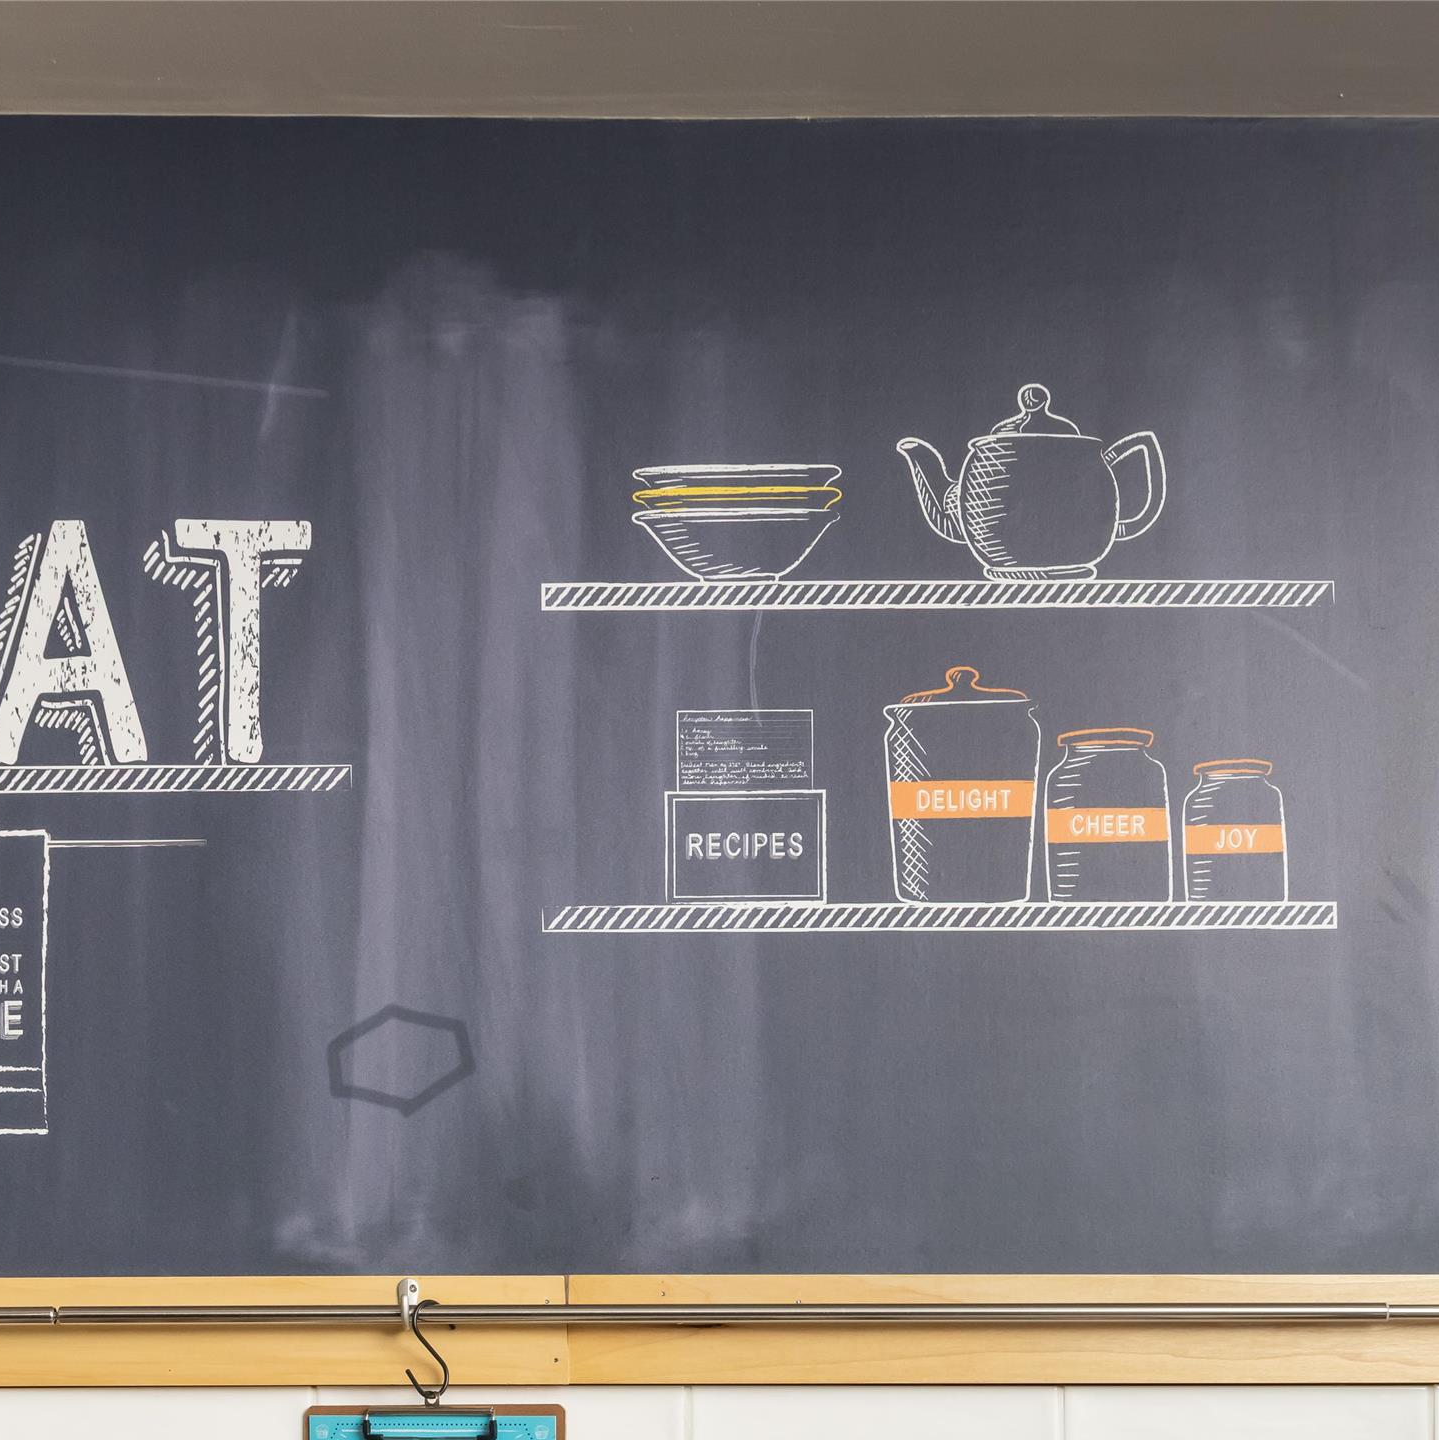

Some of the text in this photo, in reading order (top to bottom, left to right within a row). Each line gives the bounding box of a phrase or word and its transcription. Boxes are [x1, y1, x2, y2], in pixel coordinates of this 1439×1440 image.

[916, 789, 1011, 812] DELIGHT
[1070, 814, 1146, 837] CHEER
[686, 832, 804, 860] RECIPES
[1215, 829, 1258, 850] JOY
[12, 979, 24, 995] A
